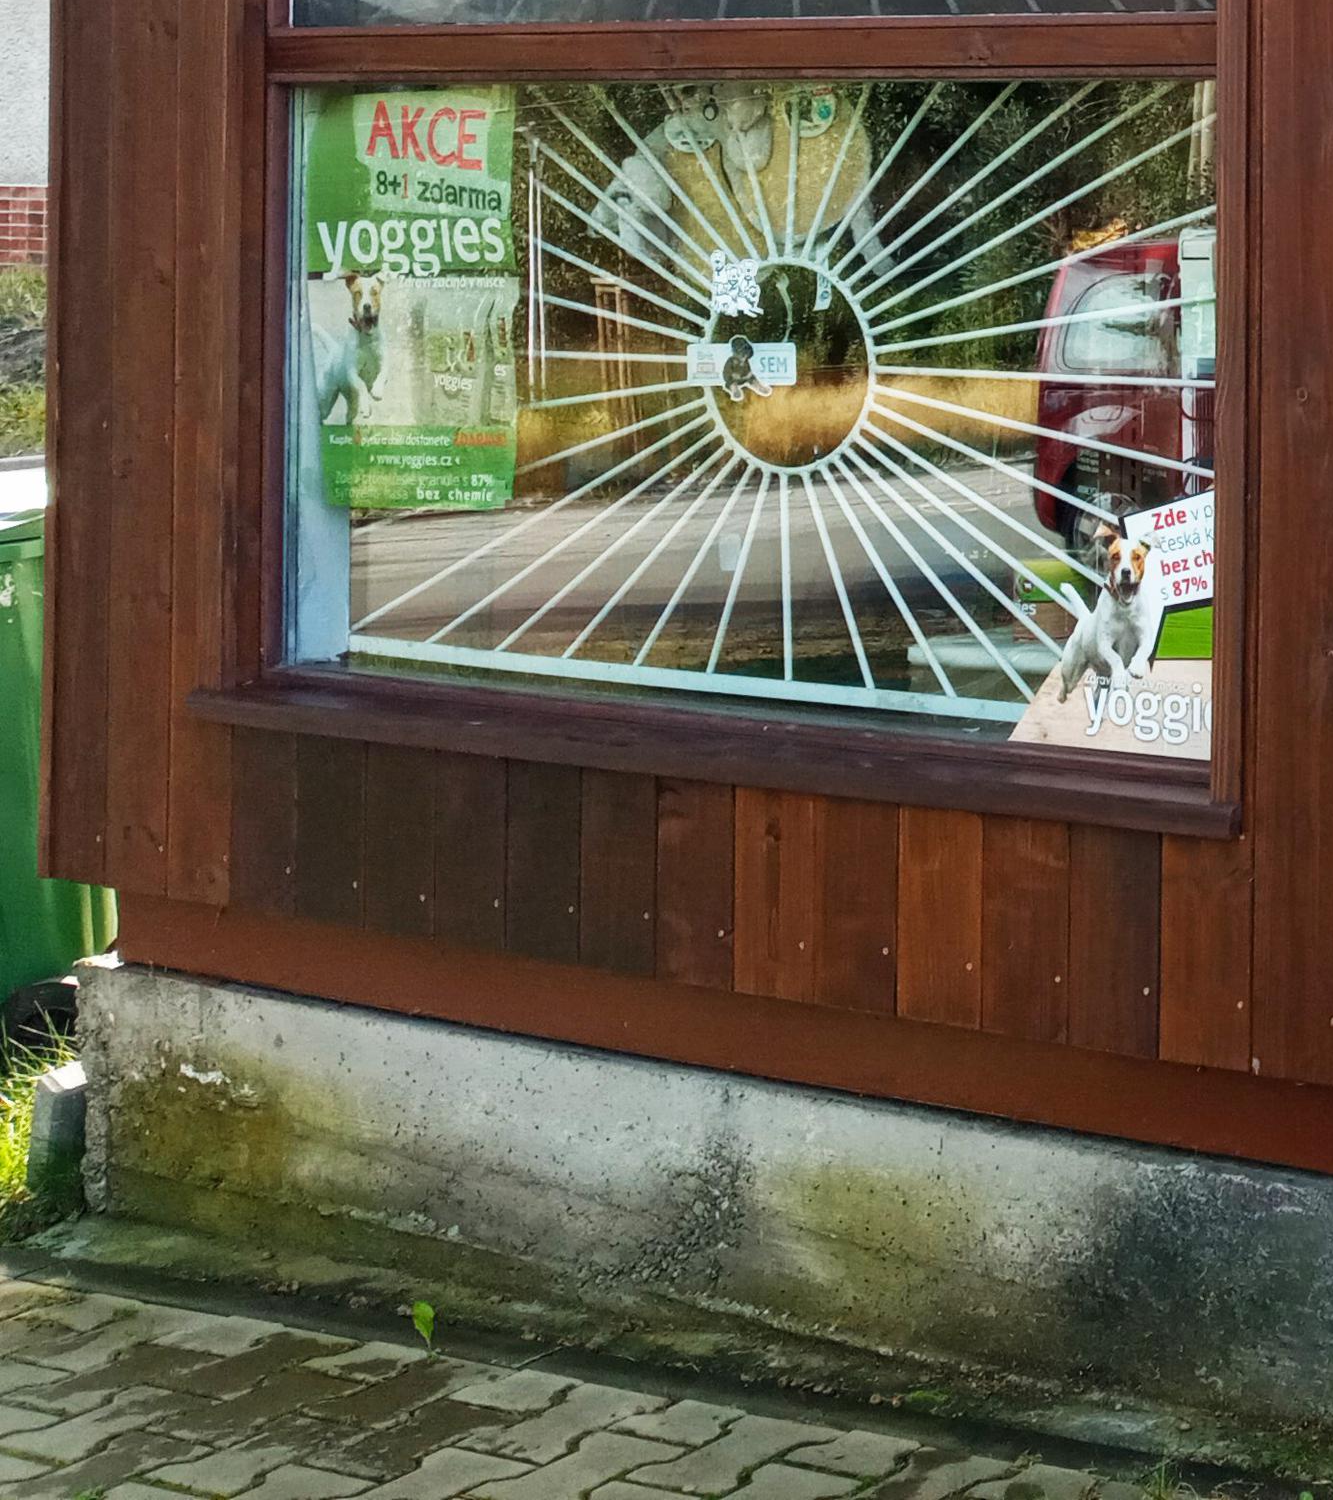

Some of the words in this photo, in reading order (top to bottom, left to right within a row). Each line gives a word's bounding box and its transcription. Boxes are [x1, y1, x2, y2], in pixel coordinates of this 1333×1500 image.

[365, 100, 487, 171] AKCE
[376, 170, 409, 199] 8+1
[416, 177, 503, 212] zdarma
[316, 216, 506, 281] yoggies
[759, 356, 788, 373] SEM
[376, 454, 452, 469] www.yoggies.cz
[470, 474, 495, 488] 87%
[416, 487, 441, 501] bez
[447, 488, 493, 502] chemie
[1152, 507, 1188, 531] Zde
[1191, 508, 1200, 522] v
[1160, 532, 1202, 554] česká
[1160, 556, 1190, 576] bez
[1172, 576, 1209, 598] 87%
[1083, 682, 1212, 743] yoggi
